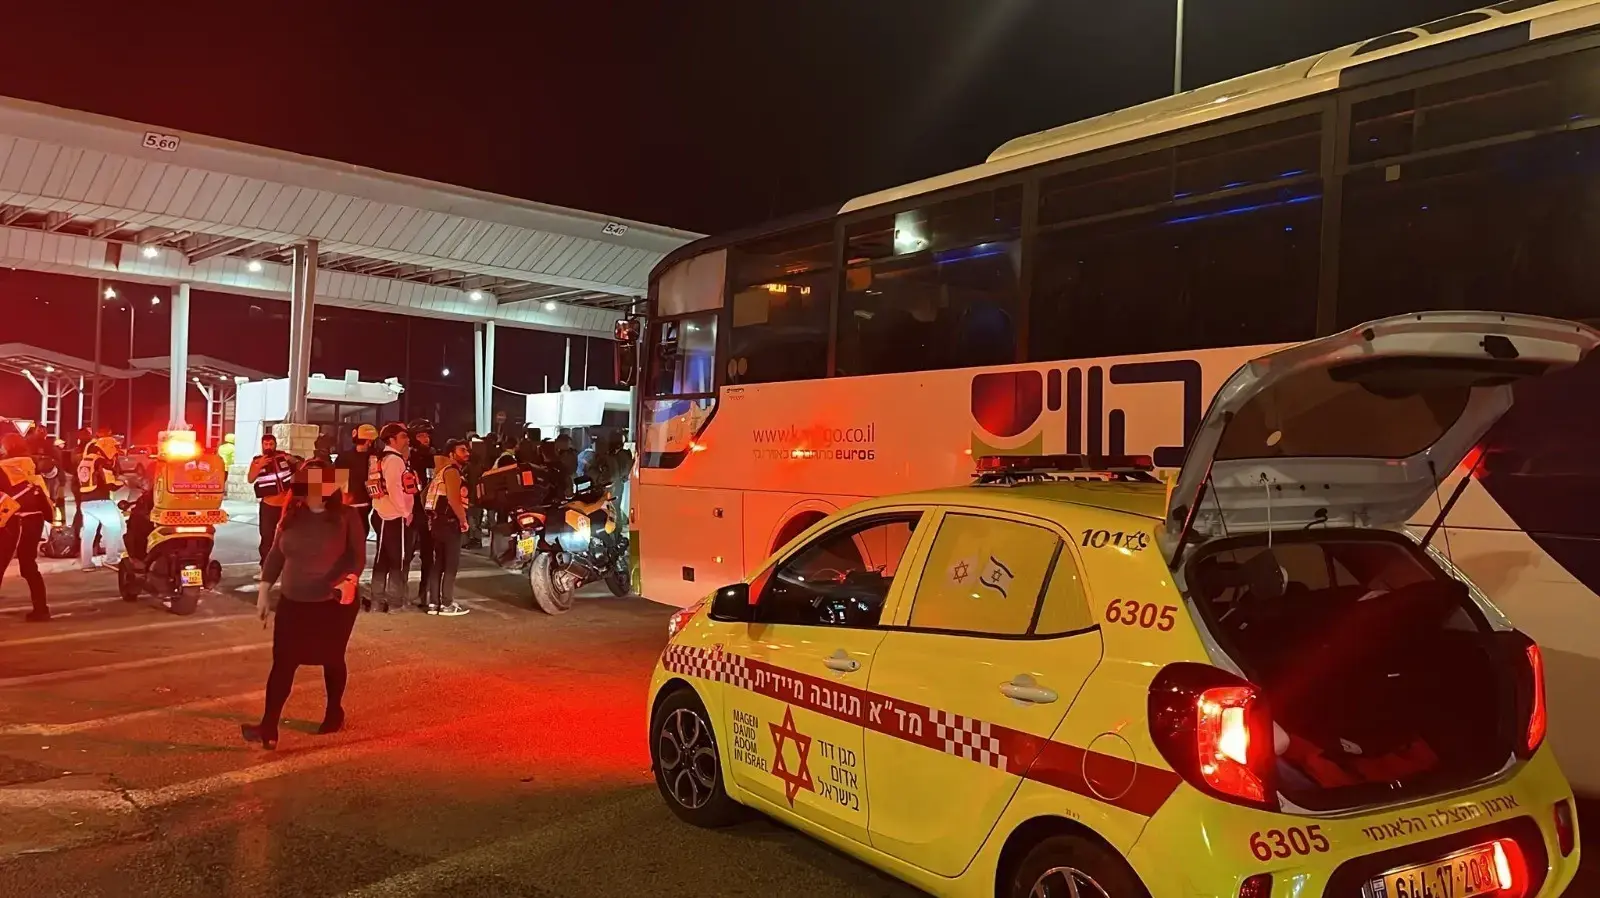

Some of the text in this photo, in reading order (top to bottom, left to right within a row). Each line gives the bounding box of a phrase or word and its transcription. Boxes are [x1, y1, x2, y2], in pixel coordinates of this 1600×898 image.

[146, 135, 176, 149] 5.60
[836, 449, 875, 460] euro6
[1081, 529, 1124, 549] 101
[1106, 598, 1178, 631] 6305
[754, 668, 804, 700] מיידית
[810, 684, 861, 718] תגובה
[733, 709, 758, 728] MAGEN
[733, 722, 756, 740] DAVID
[734, 736, 757, 755] ADOM
[817, 739, 856, 768] מגן דוד
[734, 748, 768, 773] IN ISRAEL
[830, 764, 858, 790] אדום
[817, 775, 860, 812] בישראל
[1362, 794, 1519, 841] ארגון ההצלה הלאומי
[1249, 824, 1330, 862] 6305
